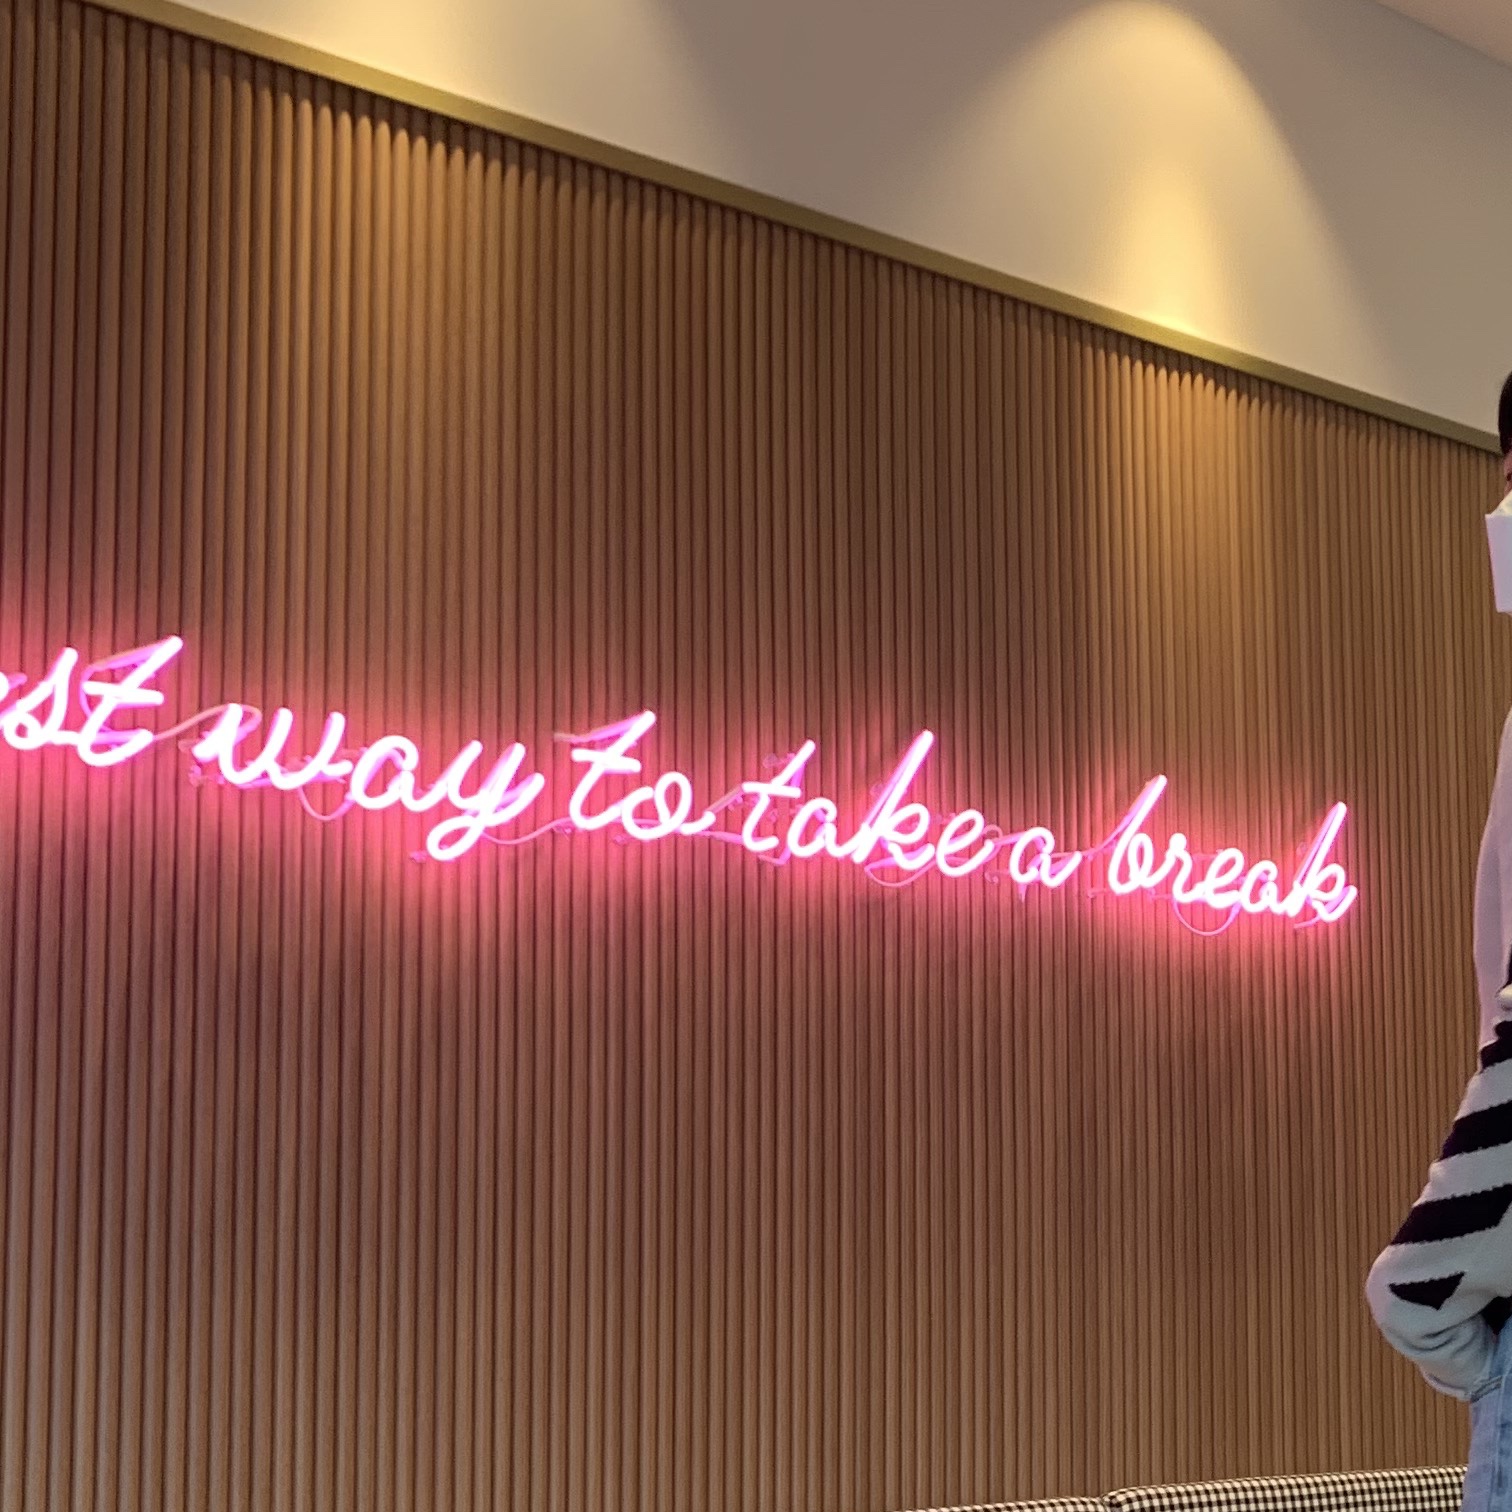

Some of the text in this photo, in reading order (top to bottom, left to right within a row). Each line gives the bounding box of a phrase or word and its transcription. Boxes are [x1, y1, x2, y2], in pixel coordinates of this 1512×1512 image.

[0, 636, 1359, 923] st way to take a break
